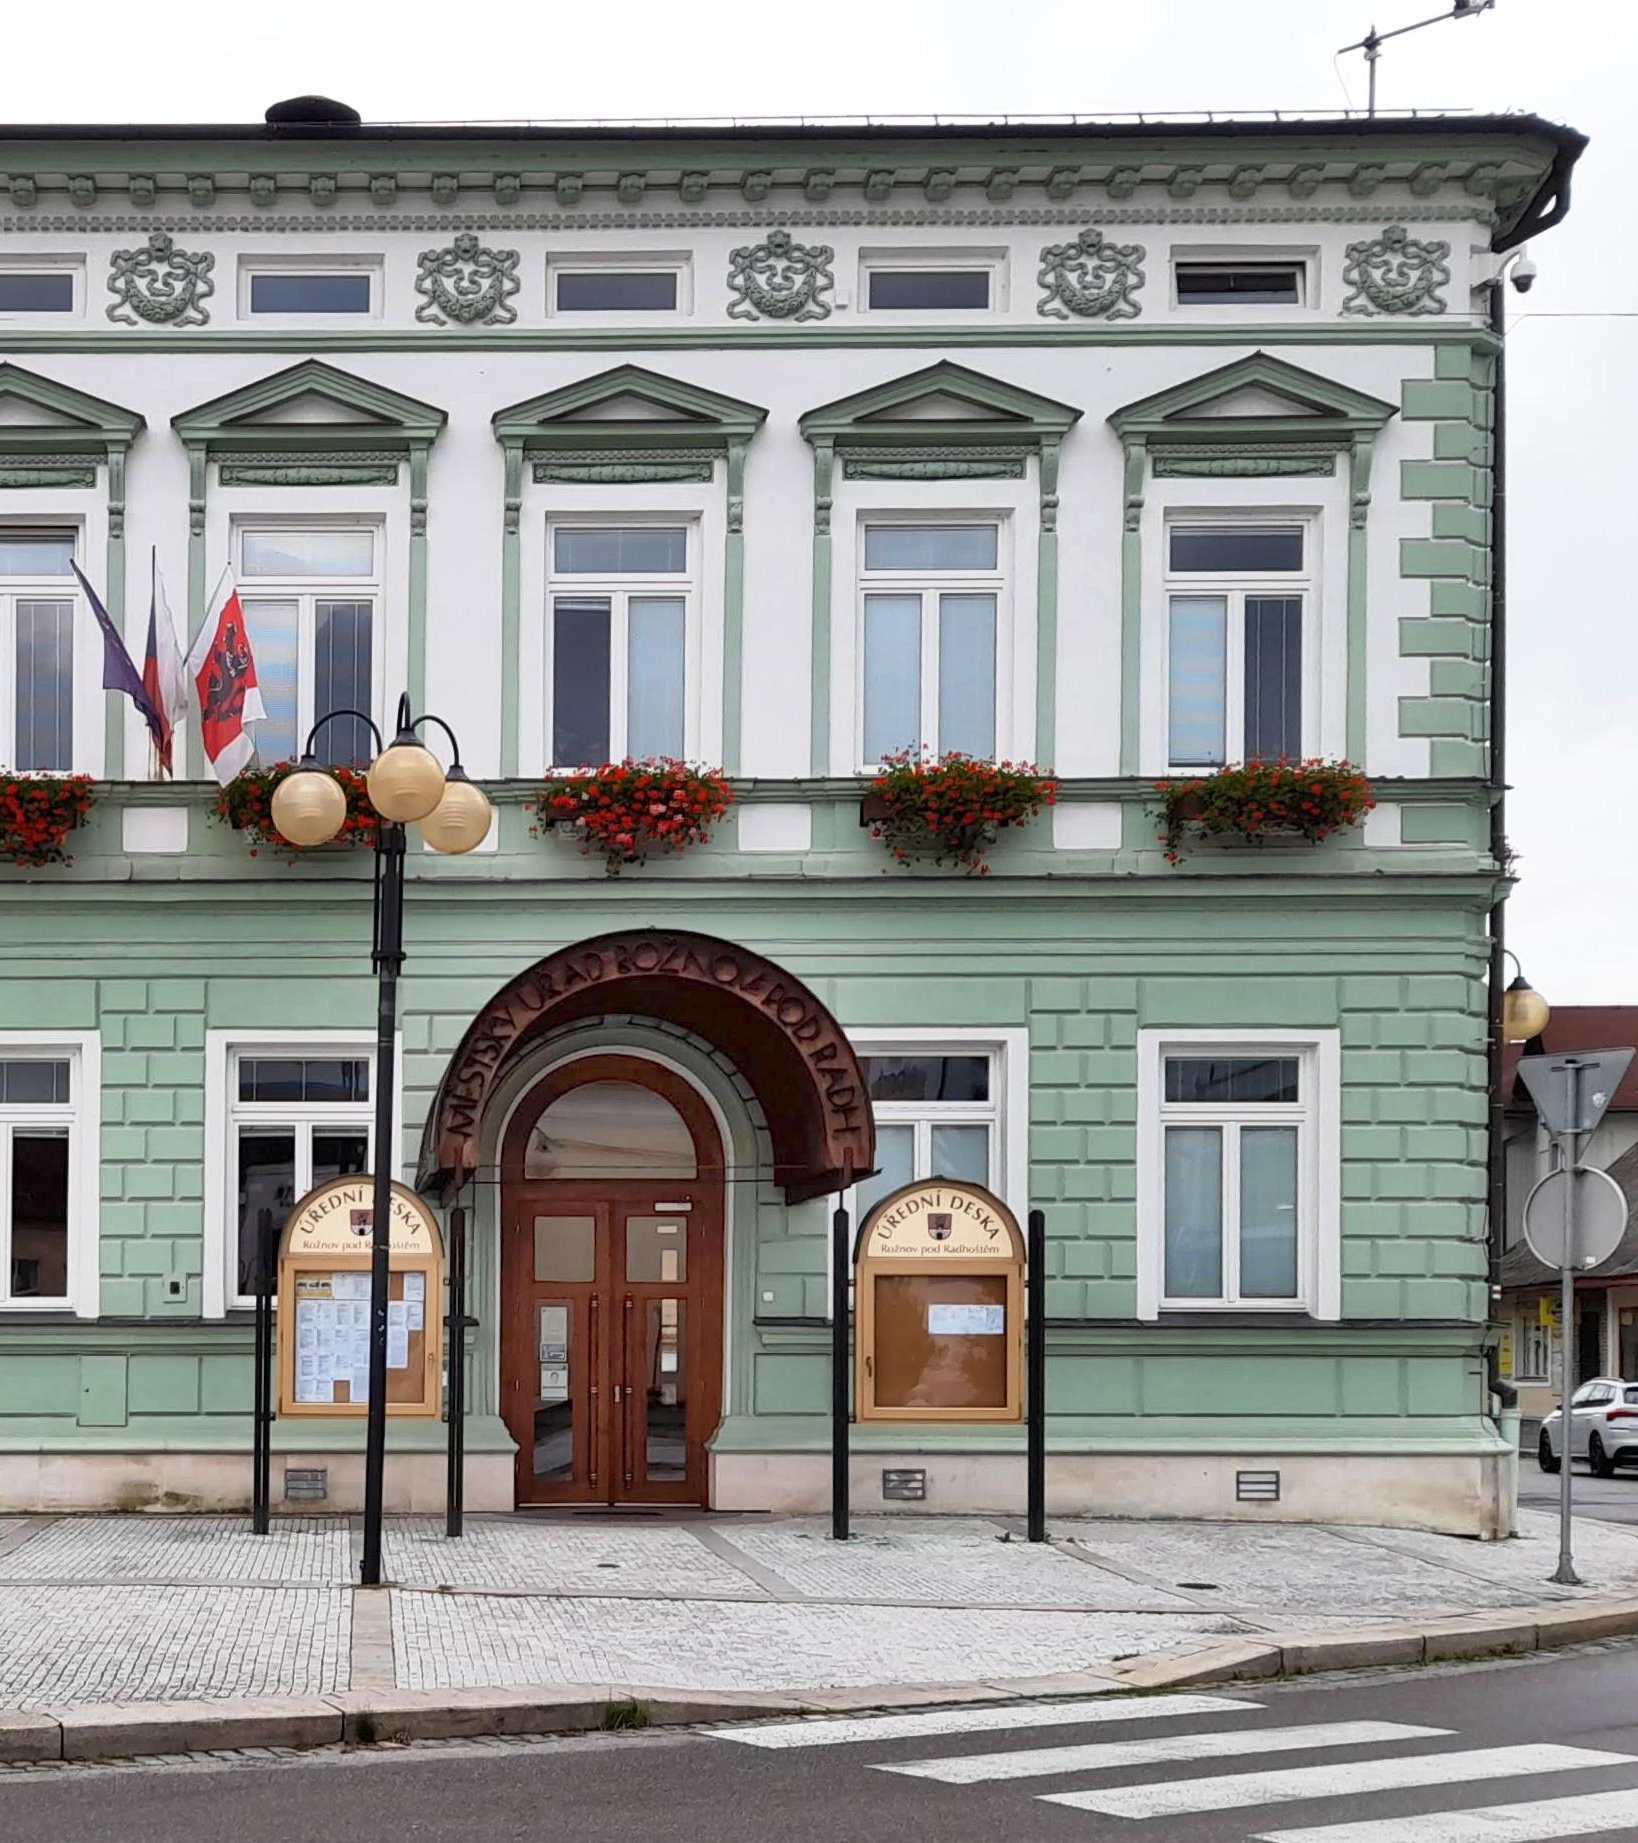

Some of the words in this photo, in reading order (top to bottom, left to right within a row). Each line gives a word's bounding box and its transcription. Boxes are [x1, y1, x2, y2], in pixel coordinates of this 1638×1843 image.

[761, 983, 823, 1042] POD
[299, 1185, 364, 1235] ÚŘEDNÍ
[372, 1194, 421, 1235] ESKA
[876, 1189, 942, 1240] ÚŘEDNÍ
[949, 1195, 1000, 1240] DESKA
[302, 1240, 340, 1250] Rožnov
[341, 1240, 362, 1252] pod
[881, 1244, 918, 1254] Rožnov
[920, 1244, 941, 1256] pod
[943, 1244, 999, 1254] Radhoštěm
